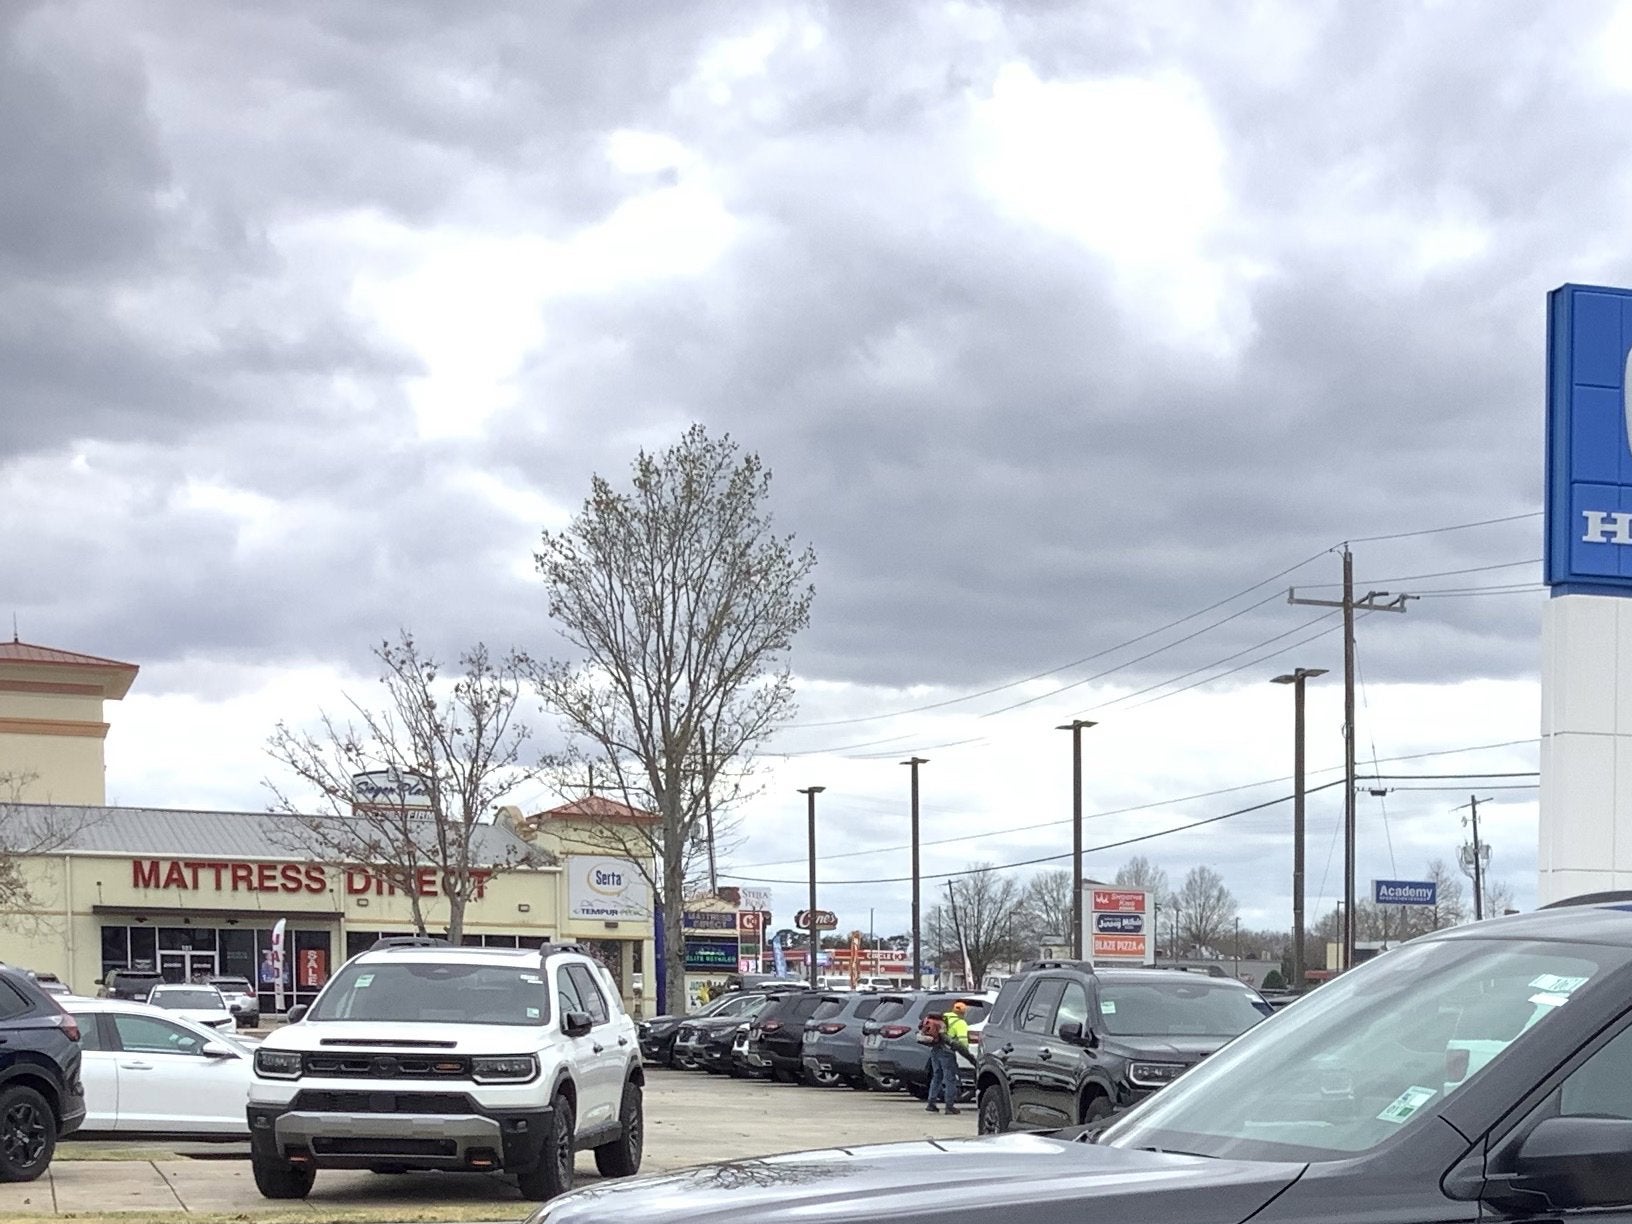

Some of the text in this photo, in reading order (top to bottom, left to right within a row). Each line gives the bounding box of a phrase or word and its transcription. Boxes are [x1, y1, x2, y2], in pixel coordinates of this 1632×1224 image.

[132, 859, 328, 894] MATTRESS
[595, 870, 622, 887] Serta
[1380, 884, 1433, 901] Academy
[687, 911, 733, 921] MATTRESS
[799, 910, 836, 928] Cne's
[693, 921, 728, 929] DIRECT
[1095, 940, 1137, 951] BLAZE PIZZA
[306, 950, 318, 986] SALE
